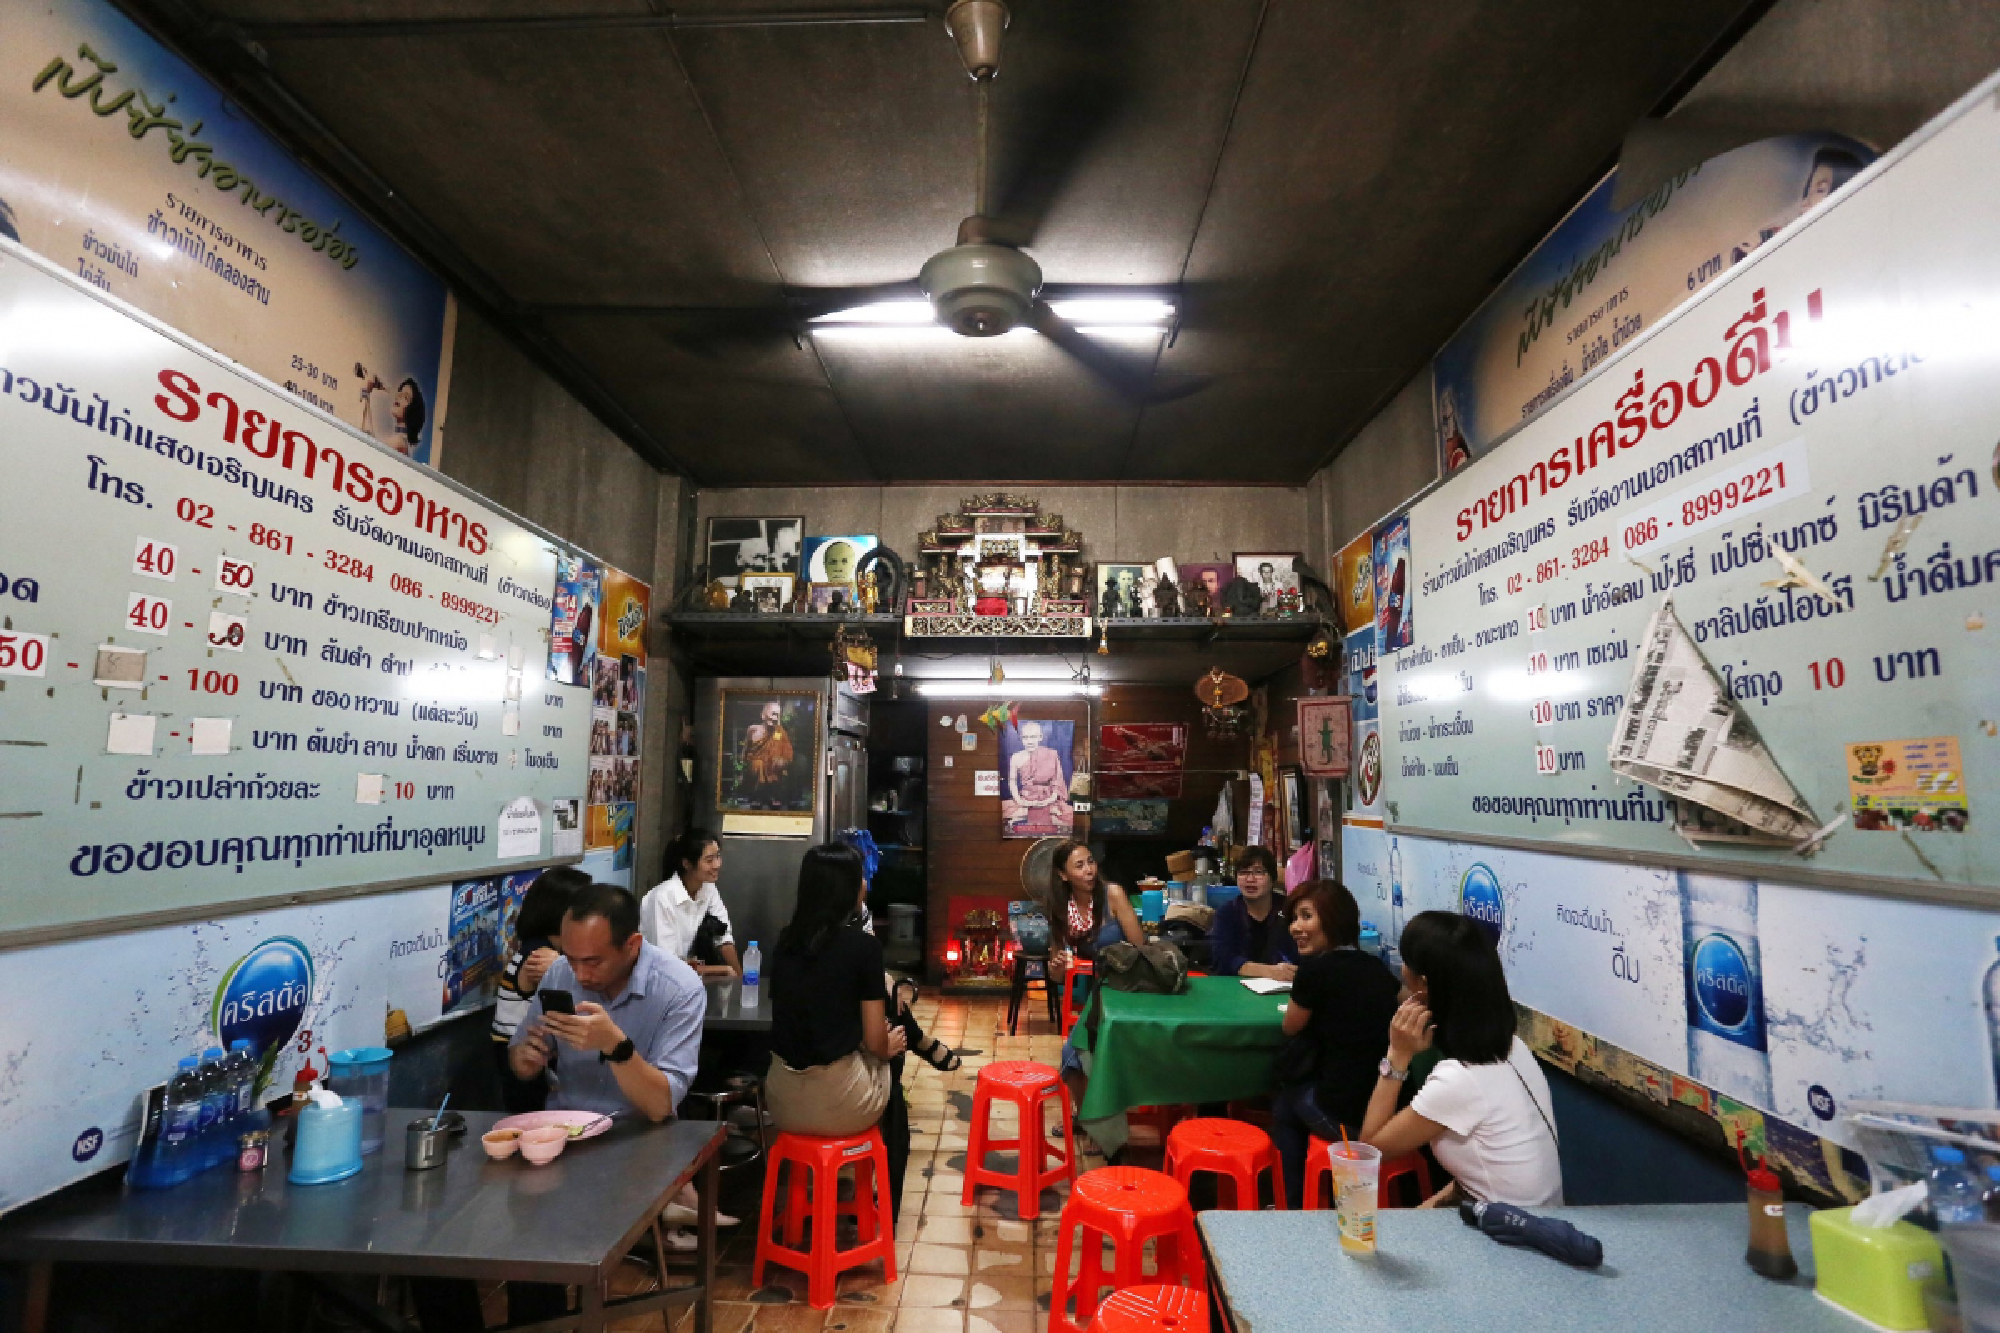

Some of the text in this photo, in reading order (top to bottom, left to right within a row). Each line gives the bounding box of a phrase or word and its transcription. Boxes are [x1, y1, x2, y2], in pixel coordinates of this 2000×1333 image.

[82, 228, 140, 279] ข้าวมันไก่
[165, 192, 267, 270] รายการอาหาร
[1687, 272, 1696, 290] 6
[1698, 253, 1723, 283] บาท
[1566, 286, 1628, 345] รายการอาหาร
[322, 372, 338, 390] บาท
[153, 368, 489, 555] รายการอาหาร
[1567, 397, 1763, 526] รับจัดงานนอกสถานที่
[87, 454, 153, 509] โทร.
[176, 497, 215, 529] 02
[248, 522, 293, 556] 861
[323, 550, 374, 582] 3284
[390, 573, 423, 599] 086
[440, 591, 499, 625] 8999221
[332, 505, 488, 585] รับจัดงานนอกสถานที่
[1478, 583, 1499, 606] โทร.
[1507, 573, 1523, 595] 02
[1572, 536, 1610, 569] 3284
[1624, 517, 1658, 550] 086
[1682, 461, 1787, 526] 8999221
[1528, 607, 1545, 631] 10
[1551, 602, 1576, 626] บาท
[1582, 579, 1644, 617] น้ำอัดลม
[1859, 453, 1979, 531] มิรินด้า
[136, 542, 174, 576] 40
[220, 560, 254, 588] 50
[271, 582, 313, 610] บาท
[323, 592, 468, 651] ข้าวเกรียบปากหม้อ
[129, 598, 168, 630] 40
[265, 632, 307, 657] บาท
[321, 637, 371, 671] ส้มตำ
[1530, 652, 1548, 673] 10
[1553, 651, 1580, 672] บาท
[188, 668, 239, 695] 100
[259, 681, 303, 704] บาท
[412, 701, 478, 730] (แต่ละวัน)
[1535, 701, 1552, 723] 10
[1555, 700, 1581, 721] บาท
[1721, 659, 1783, 706] ใส่ถุง
[1808, 657, 1846, 691] 10
[1873, 647, 1941, 682] บาท
[253, 730, 297, 751] บาท
[307, 726, 358, 755] ต้มยำ
[364, 739, 397, 757] ลาบ
[406, 734, 446, 761] น้ำตก
[1538, 748, 1555, 771] 10
[1558, 751, 1585, 770] บาท
[125, 768, 320, 800] ข้าวเปล่าถ้วยละ
[395, 782, 415, 799] 10
[427, 784, 454, 800] บาท
[69, 817, 485, 876] ขอขอบคุณทุกท่านที่มาอุดหนุน
[1613, 933, 1640, 983] ดื่ม
[1697, 968, 1748, 996] คริสตัล
[223, 980, 307, 1027] คริสตัล
[298, 1030, 312, 1053] 3
